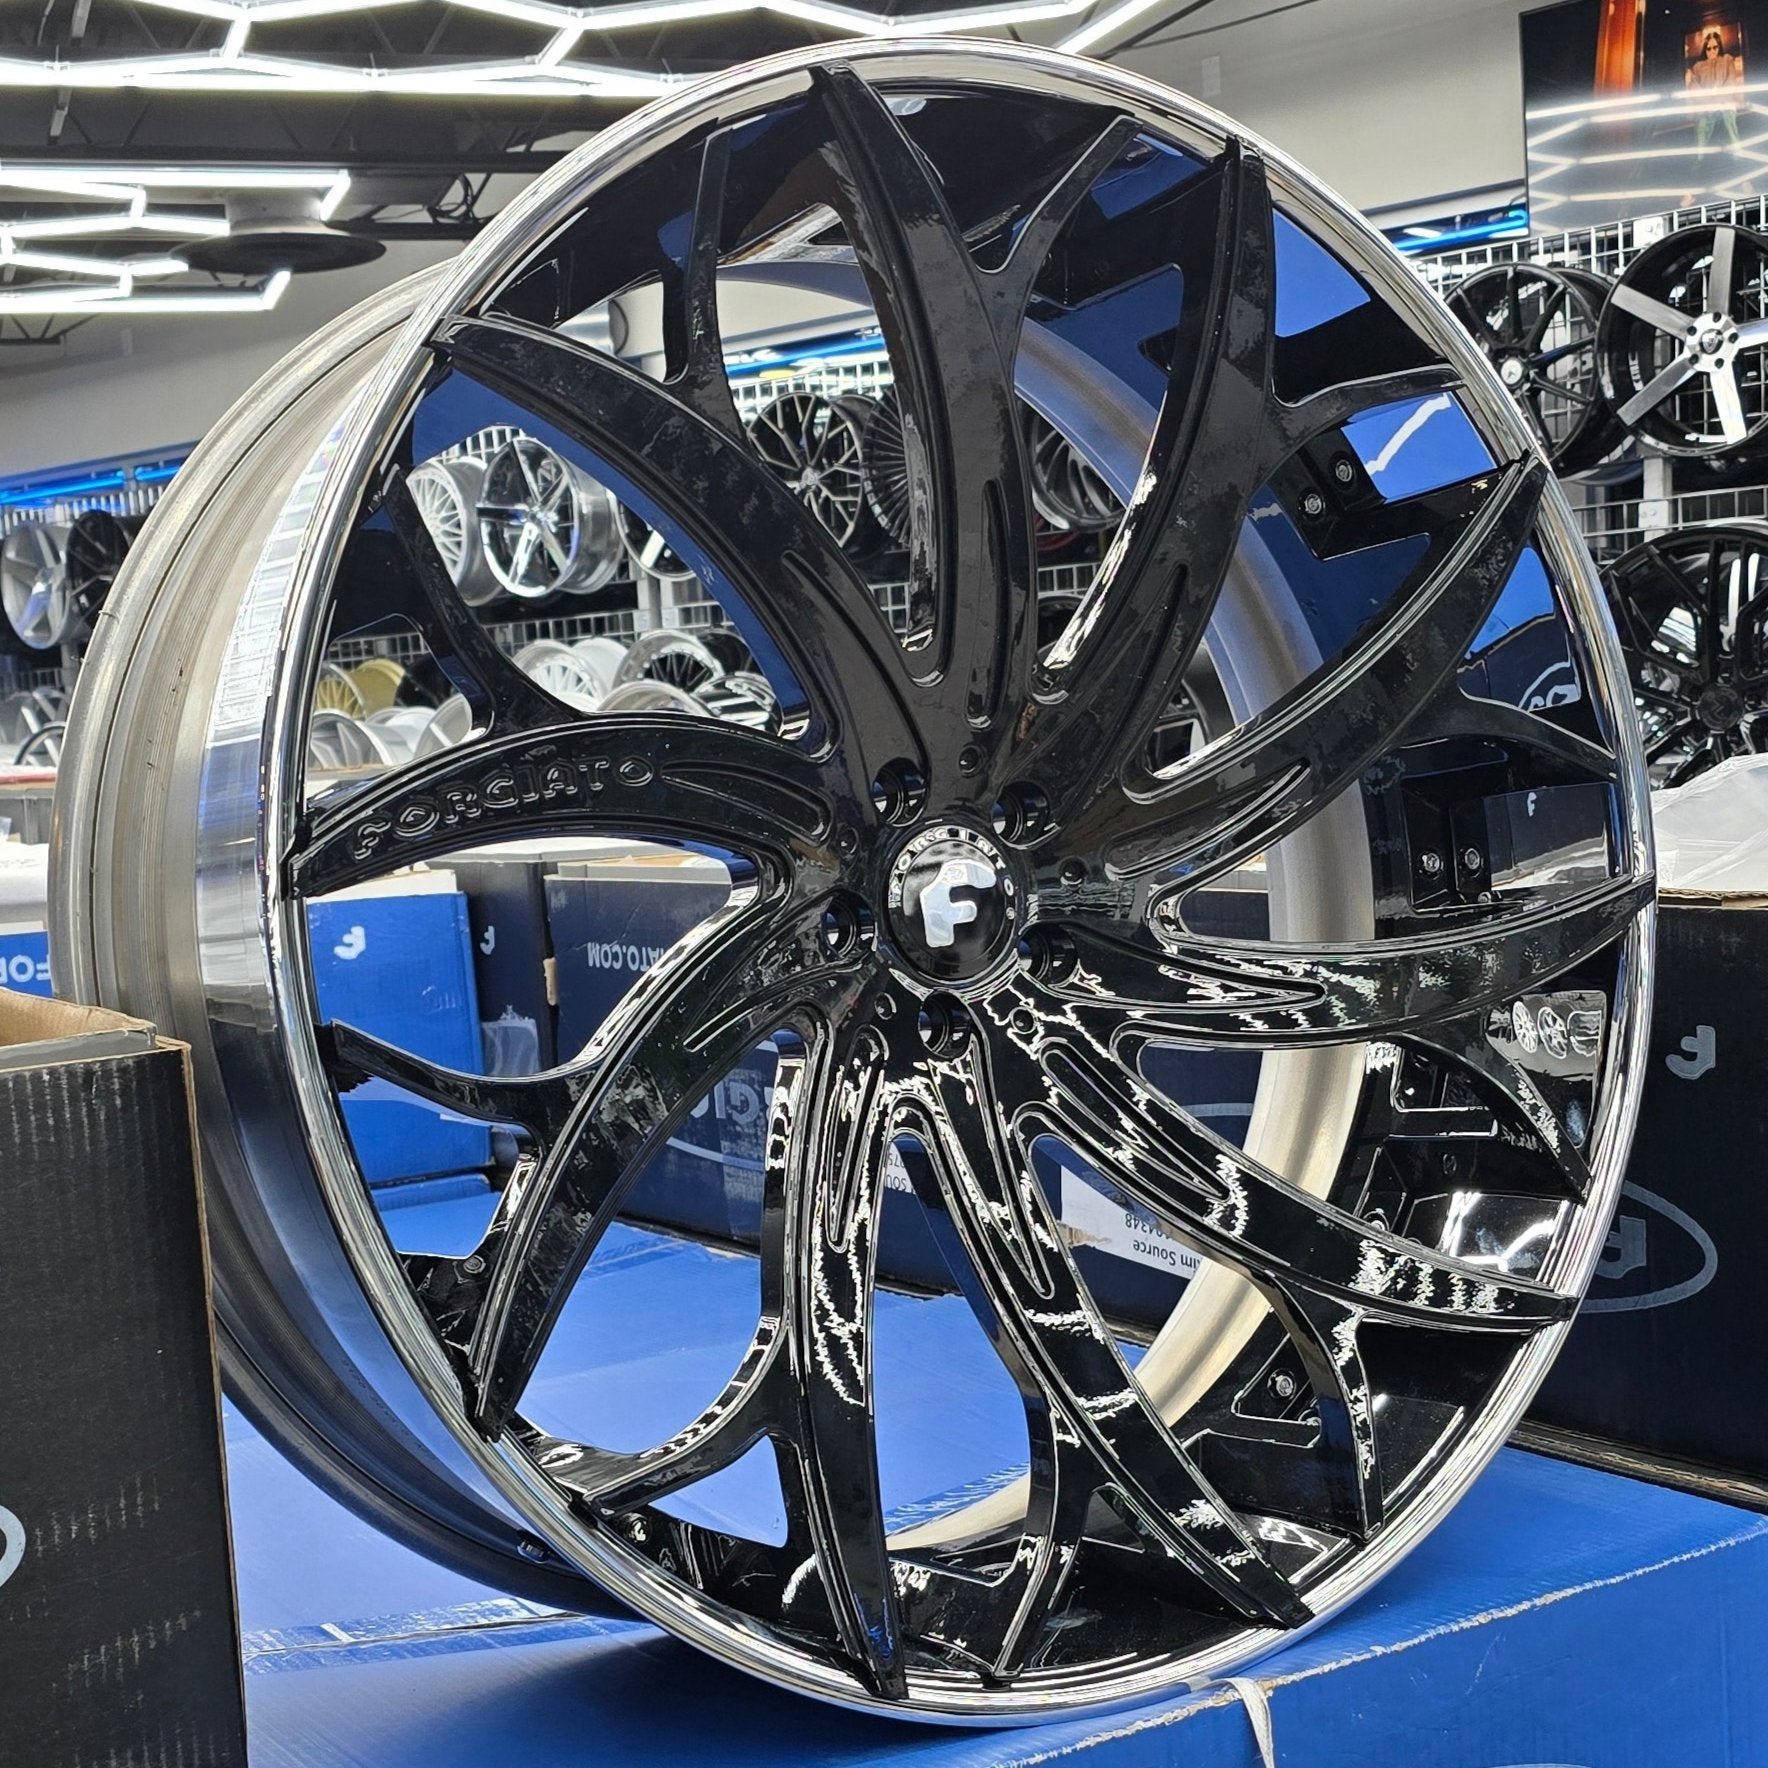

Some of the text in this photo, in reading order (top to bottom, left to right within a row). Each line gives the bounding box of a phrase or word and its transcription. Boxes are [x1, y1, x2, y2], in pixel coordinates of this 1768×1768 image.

[353, 757, 656, 862] FORGIATO
[1132, 1239, 1201, 1273] im Source
